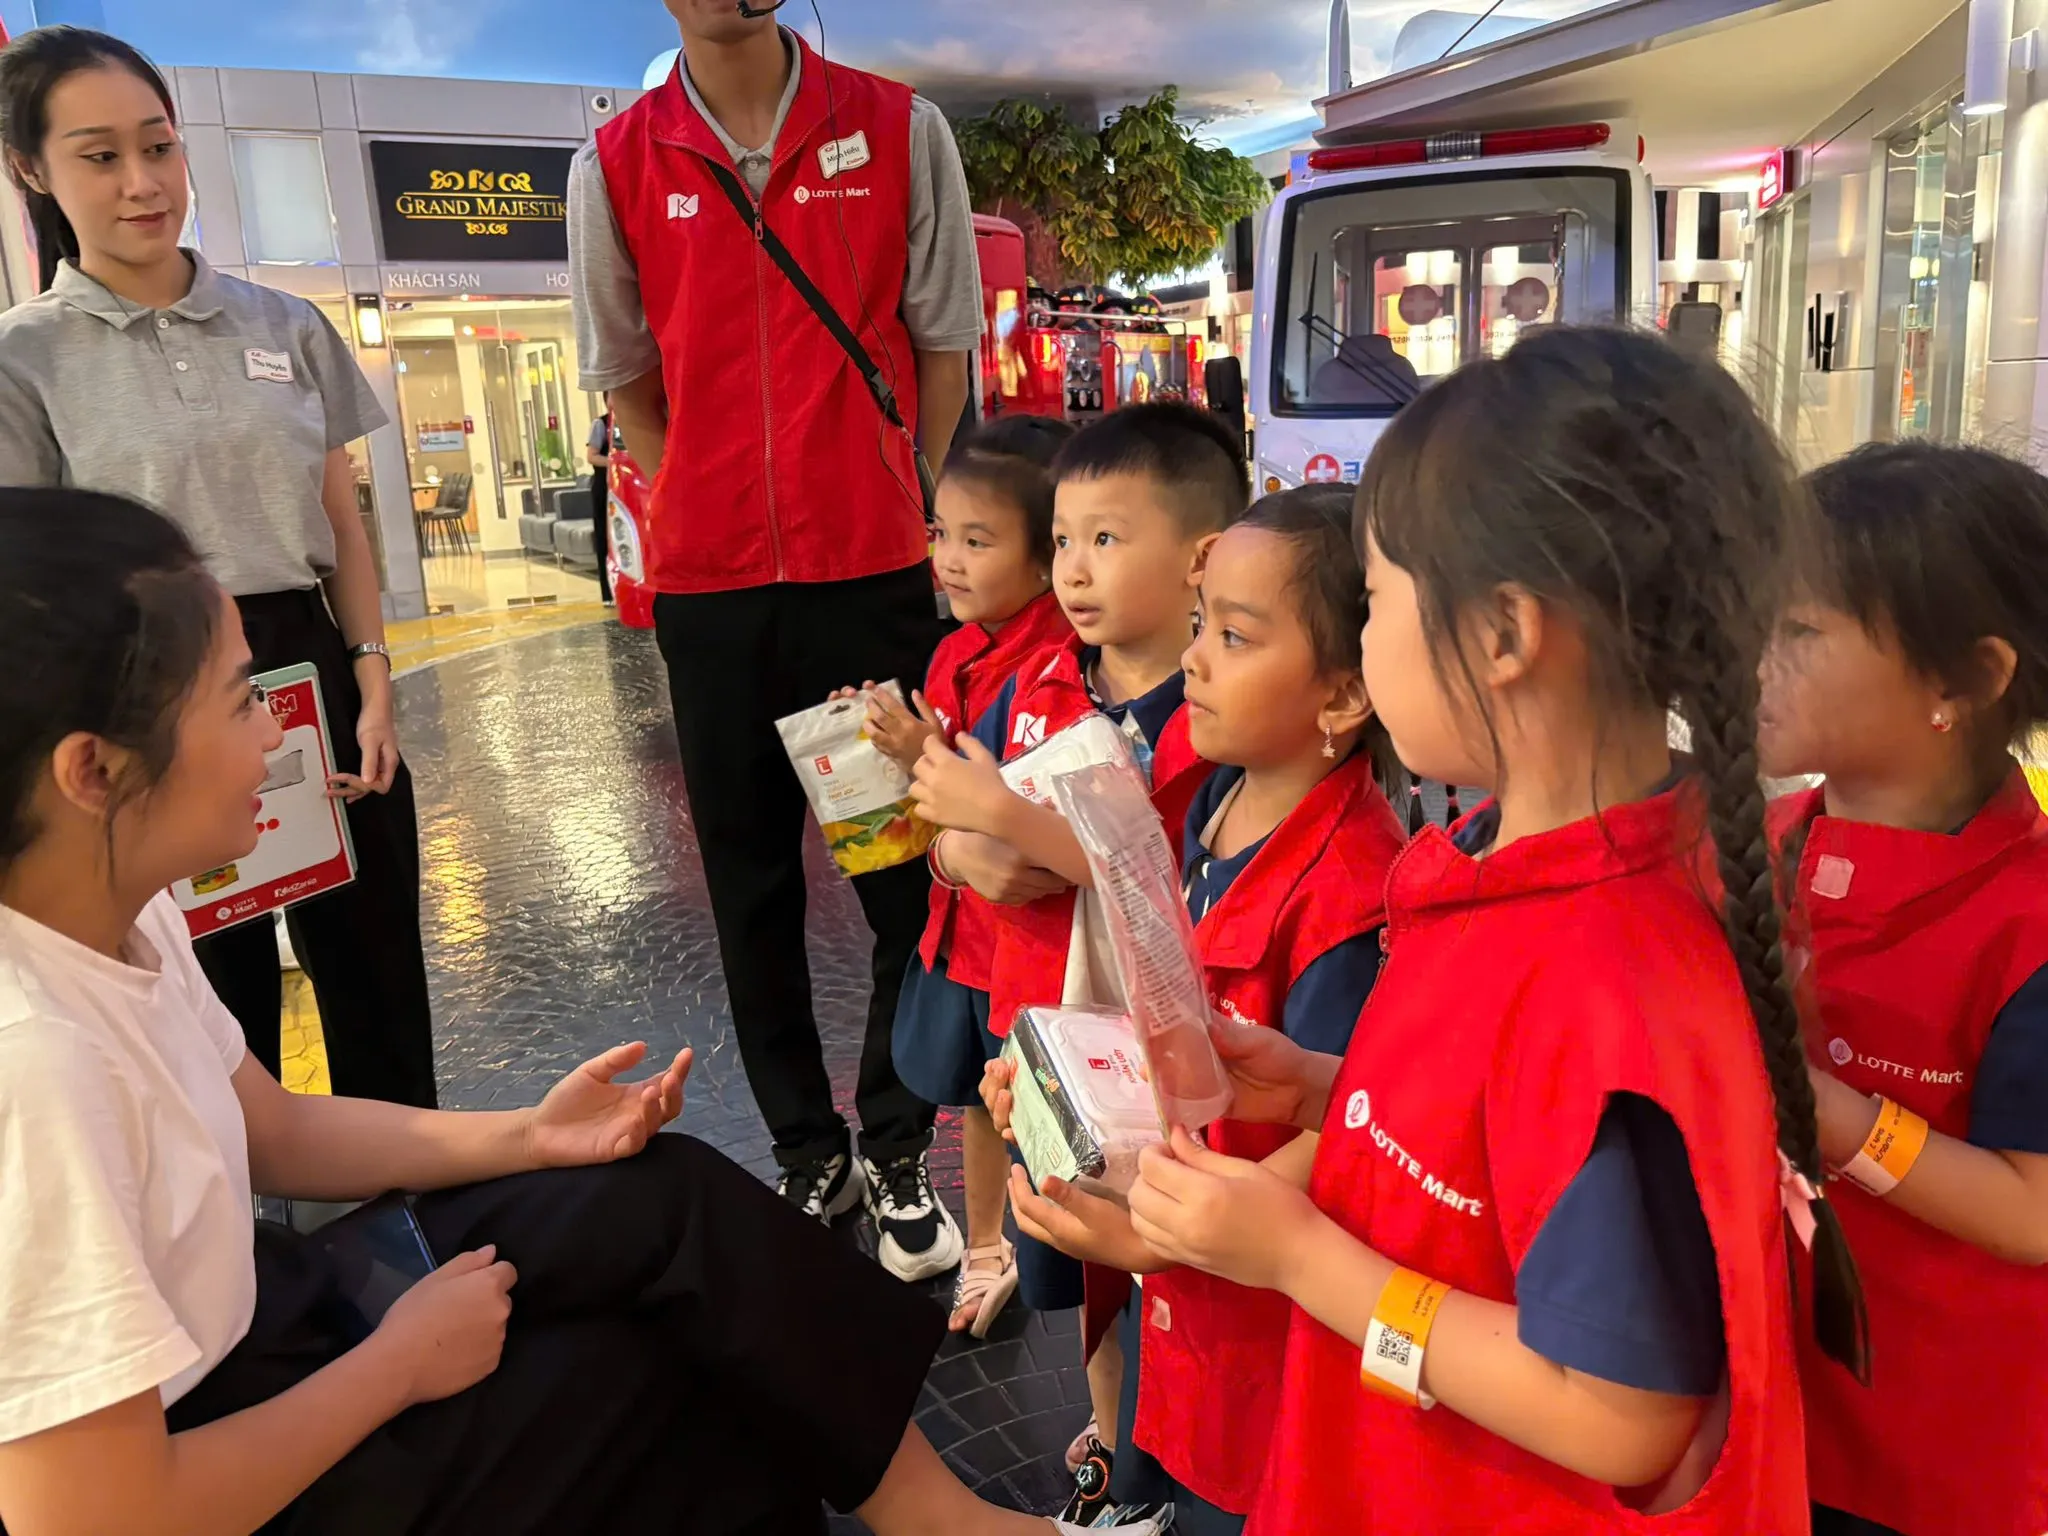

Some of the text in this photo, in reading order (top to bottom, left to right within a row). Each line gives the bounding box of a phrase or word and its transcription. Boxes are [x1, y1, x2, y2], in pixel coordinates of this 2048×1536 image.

[811, 187, 871, 198] LOTTE Mart
[396, 195, 567, 217] GRAND MAJESTIK
[388, 268, 480, 291] KHÁCH SẠN
[546, 273, 571, 288] HO
[234, 901, 258, 915] Mart
[1858, 1053, 1964, 1084] LOTTE Mart
[1370, 1121, 1484, 1217] LOTTE Mart
